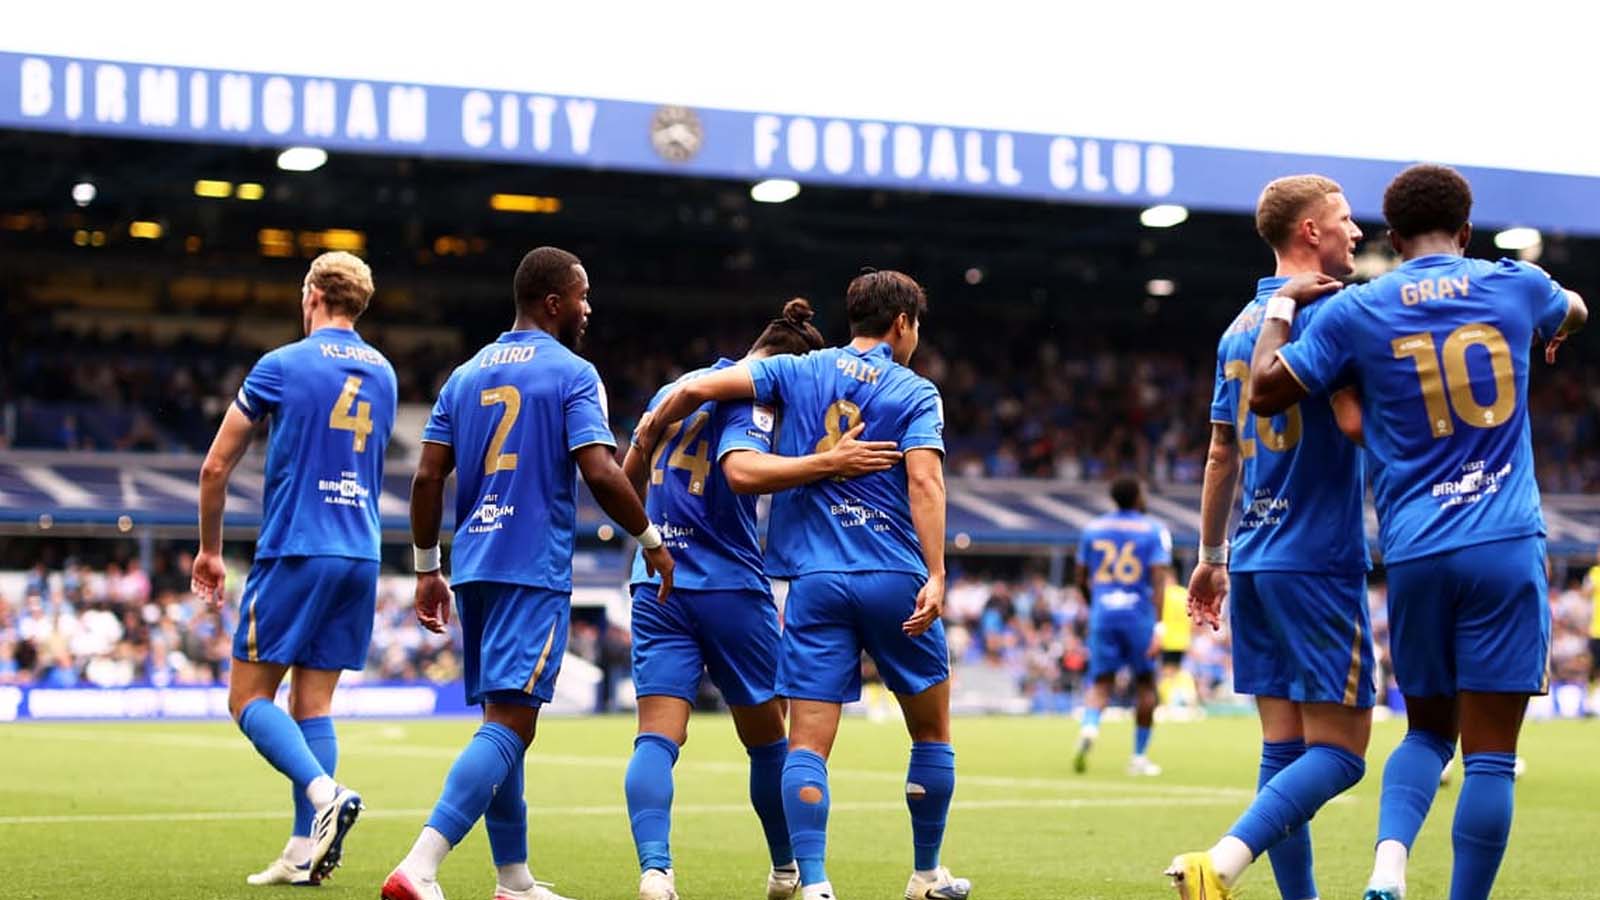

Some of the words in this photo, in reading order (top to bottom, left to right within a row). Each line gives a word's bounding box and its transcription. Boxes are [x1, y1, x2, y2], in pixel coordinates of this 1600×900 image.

[20, 57, 427, 143] BIRMINGHAM
[461, 89, 597, 154] CITY
[753, 114, 1022, 188] FOOTBALL
[1049, 136, 1175, 197] CLUB
[1401, 274, 1470, 306] GRAY
[480, 345, 536, 368] LAIRD
[1391, 322, 1516, 438] 10
[329, 375, 374, 452] 4
[481, 385, 521, 477] 2
[1092, 538, 1143, 585] 26
